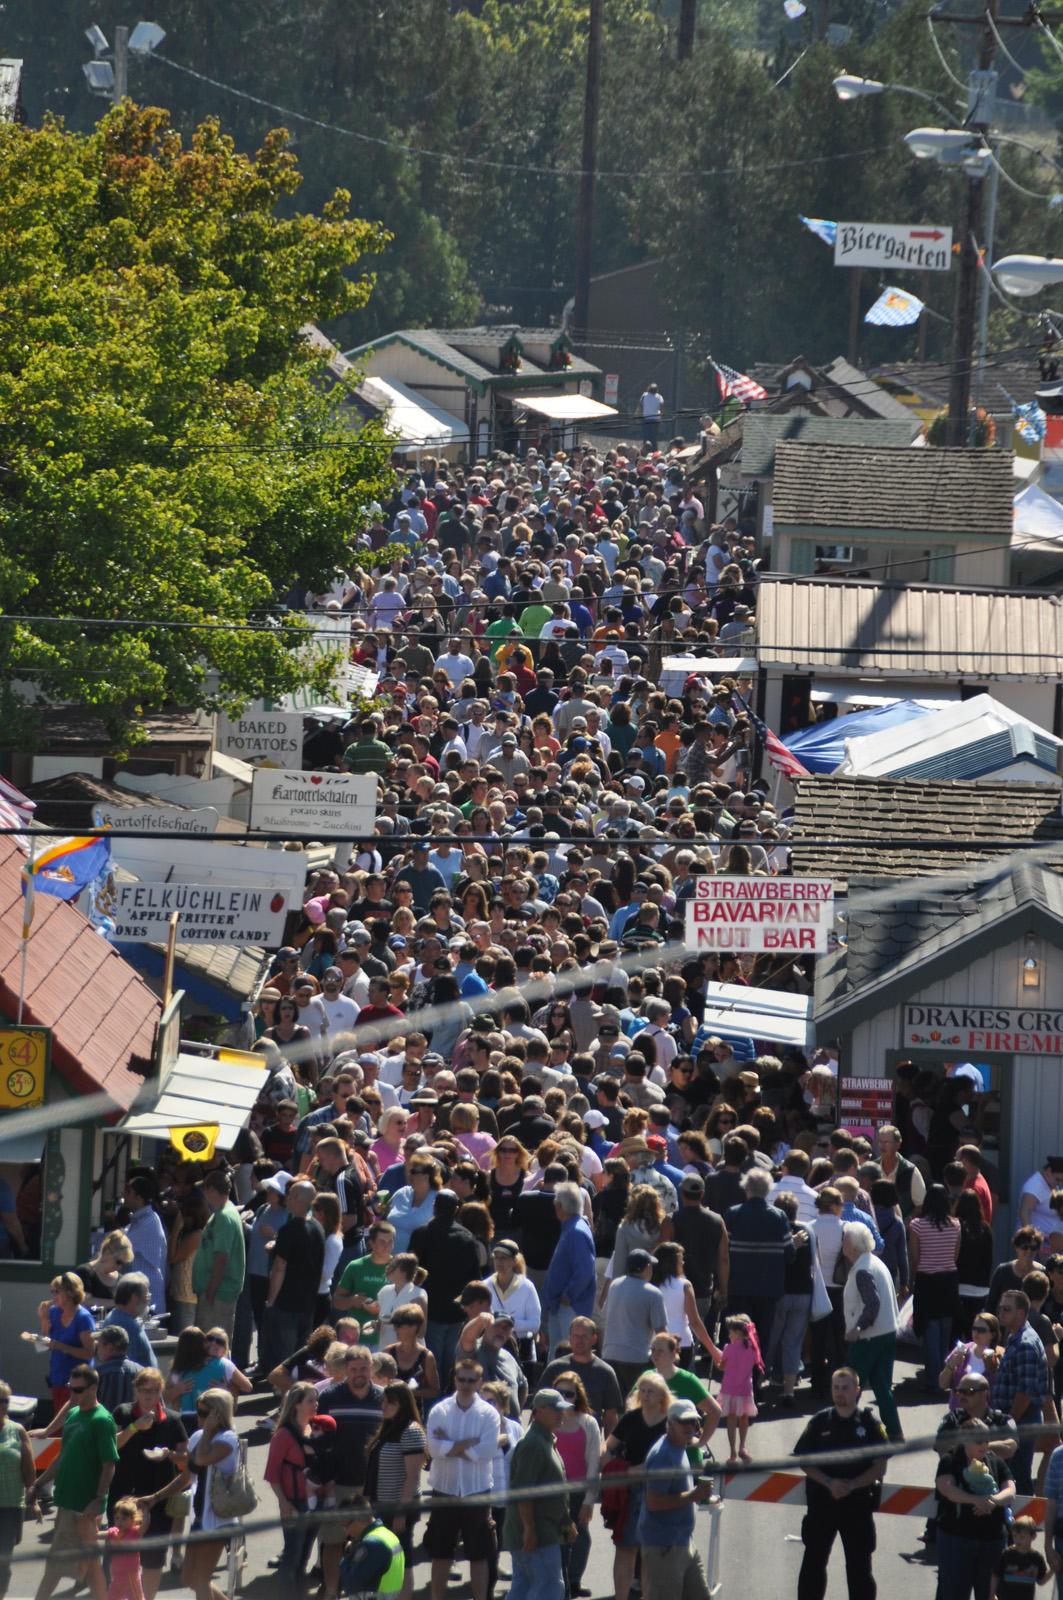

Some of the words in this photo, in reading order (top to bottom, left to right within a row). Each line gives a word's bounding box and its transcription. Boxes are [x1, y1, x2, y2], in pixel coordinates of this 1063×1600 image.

[841, 226, 947, 268] Biergarten
[238, 721, 287, 735] BAKED
[227, 736, 298, 752] POTATOES
[290, 807, 318, 816] potato
[320, 807, 342, 817] skins
[103, 814, 208, 833] Kartoffelschalen
[263, 817, 311, 828] Mushrooms
[322, 821, 363, 831] Zucchini
[120, 886, 262, 912] FELKÜCHLEIN
[698, 881, 833, 899] STRAWBERRY
[694, 902, 820, 923] BAVARIAN
[181, 928, 226, 940] COTTON
[230, 930, 272, 942] CANDY
[697, 927, 751, 948] NUT
[763, 928, 816, 949] BAR
[907, 1007, 1011, 1030] DRAKES
[842, 1077, 893, 1090] STRAWBERRY
